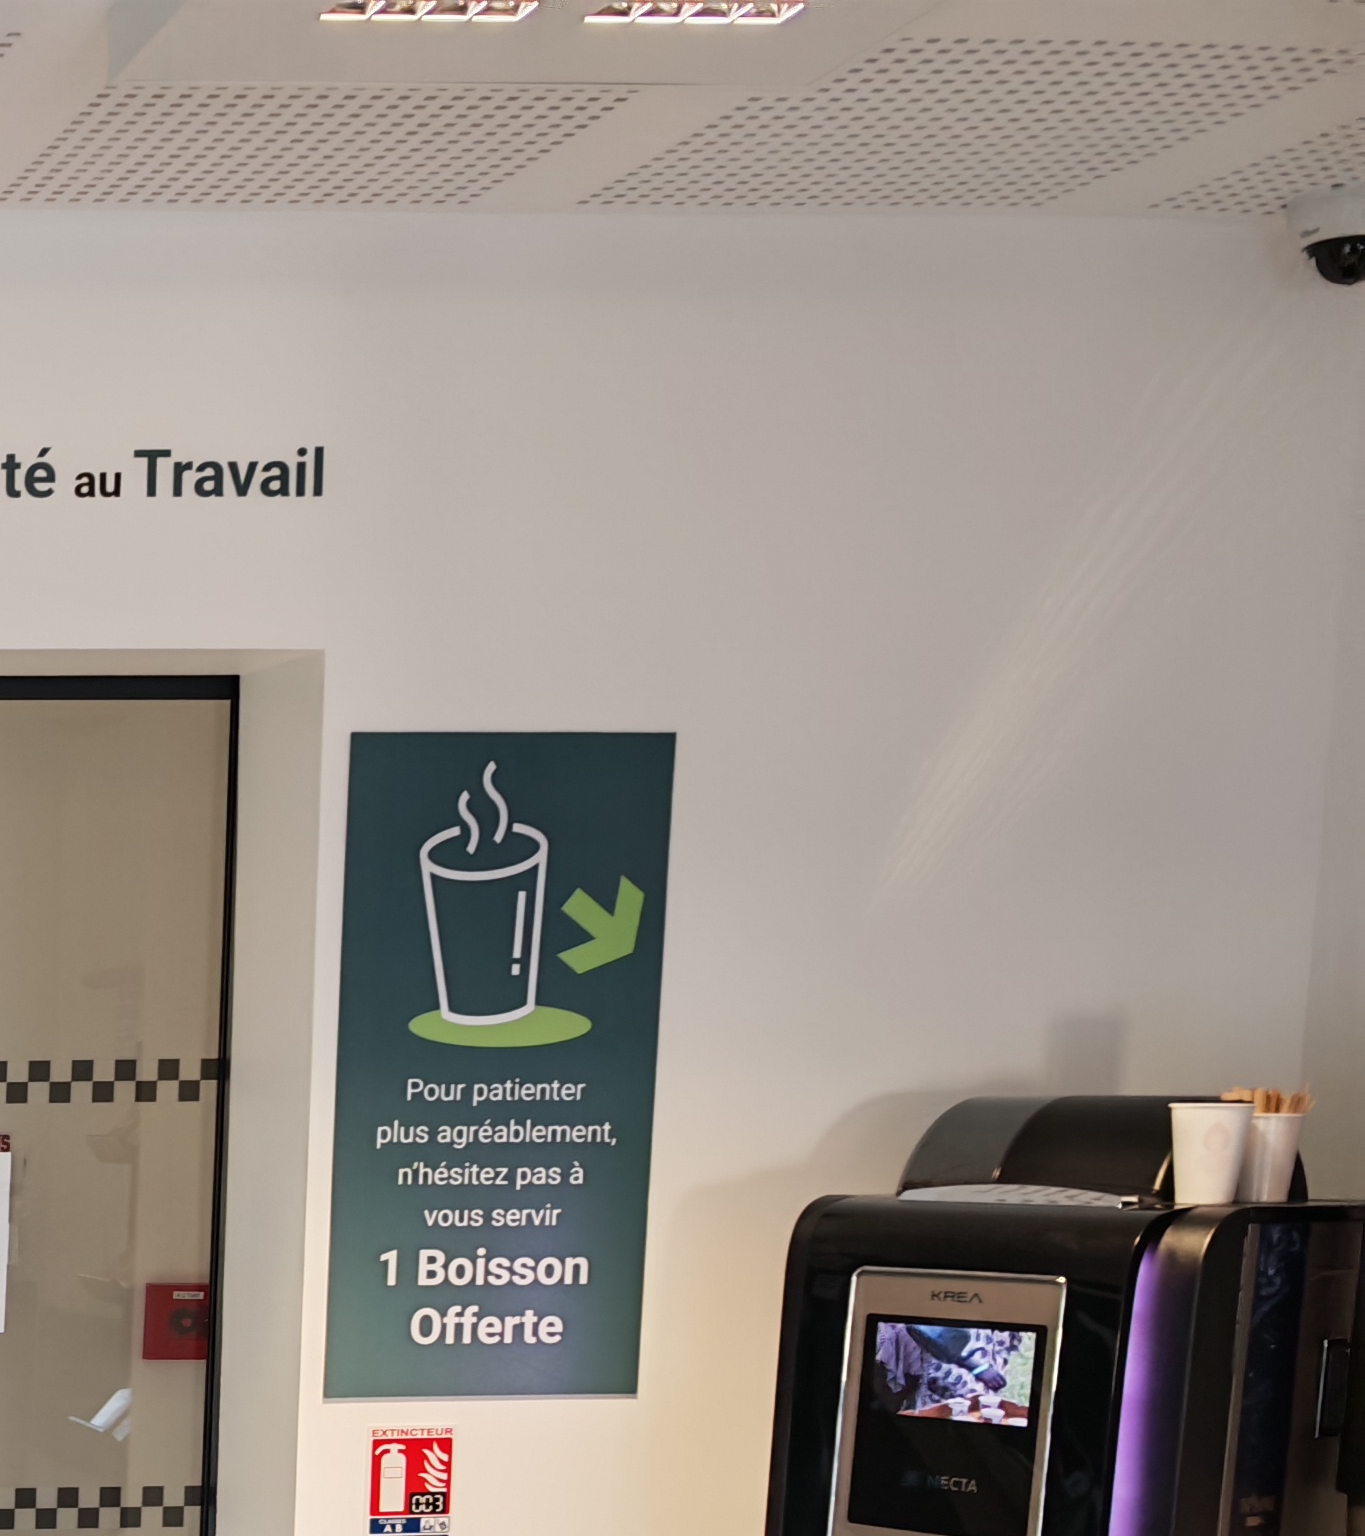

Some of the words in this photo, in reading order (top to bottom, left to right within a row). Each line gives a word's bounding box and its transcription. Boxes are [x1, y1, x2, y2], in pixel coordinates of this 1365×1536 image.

[75, 472, 121, 498] au
[134, 447, 324, 497] Travail
[407, 1079, 466, 1101] Pour
[473, 1078, 586, 1106] patienter
[376, 1120, 429, 1149] plus
[437, 1119, 616, 1148] agréablement,
[398, 1162, 508, 1185] n'hésitez
[516, 1167, 561, 1190] pas
[570, 1161, 583, 1184] à
[424, 1209, 483, 1226] vous
[492, 1204, 561, 1226] servir
[380, 1250, 397, 1286] 1
[418, 1248, 588, 1285] Boisson
[411, 1305, 563, 1344] Offerte
[371, 1427, 454, 1438] EXTINCTEUR
[383, 1524, 392, 1533] A
[395, 1524, 403, 1533] B
